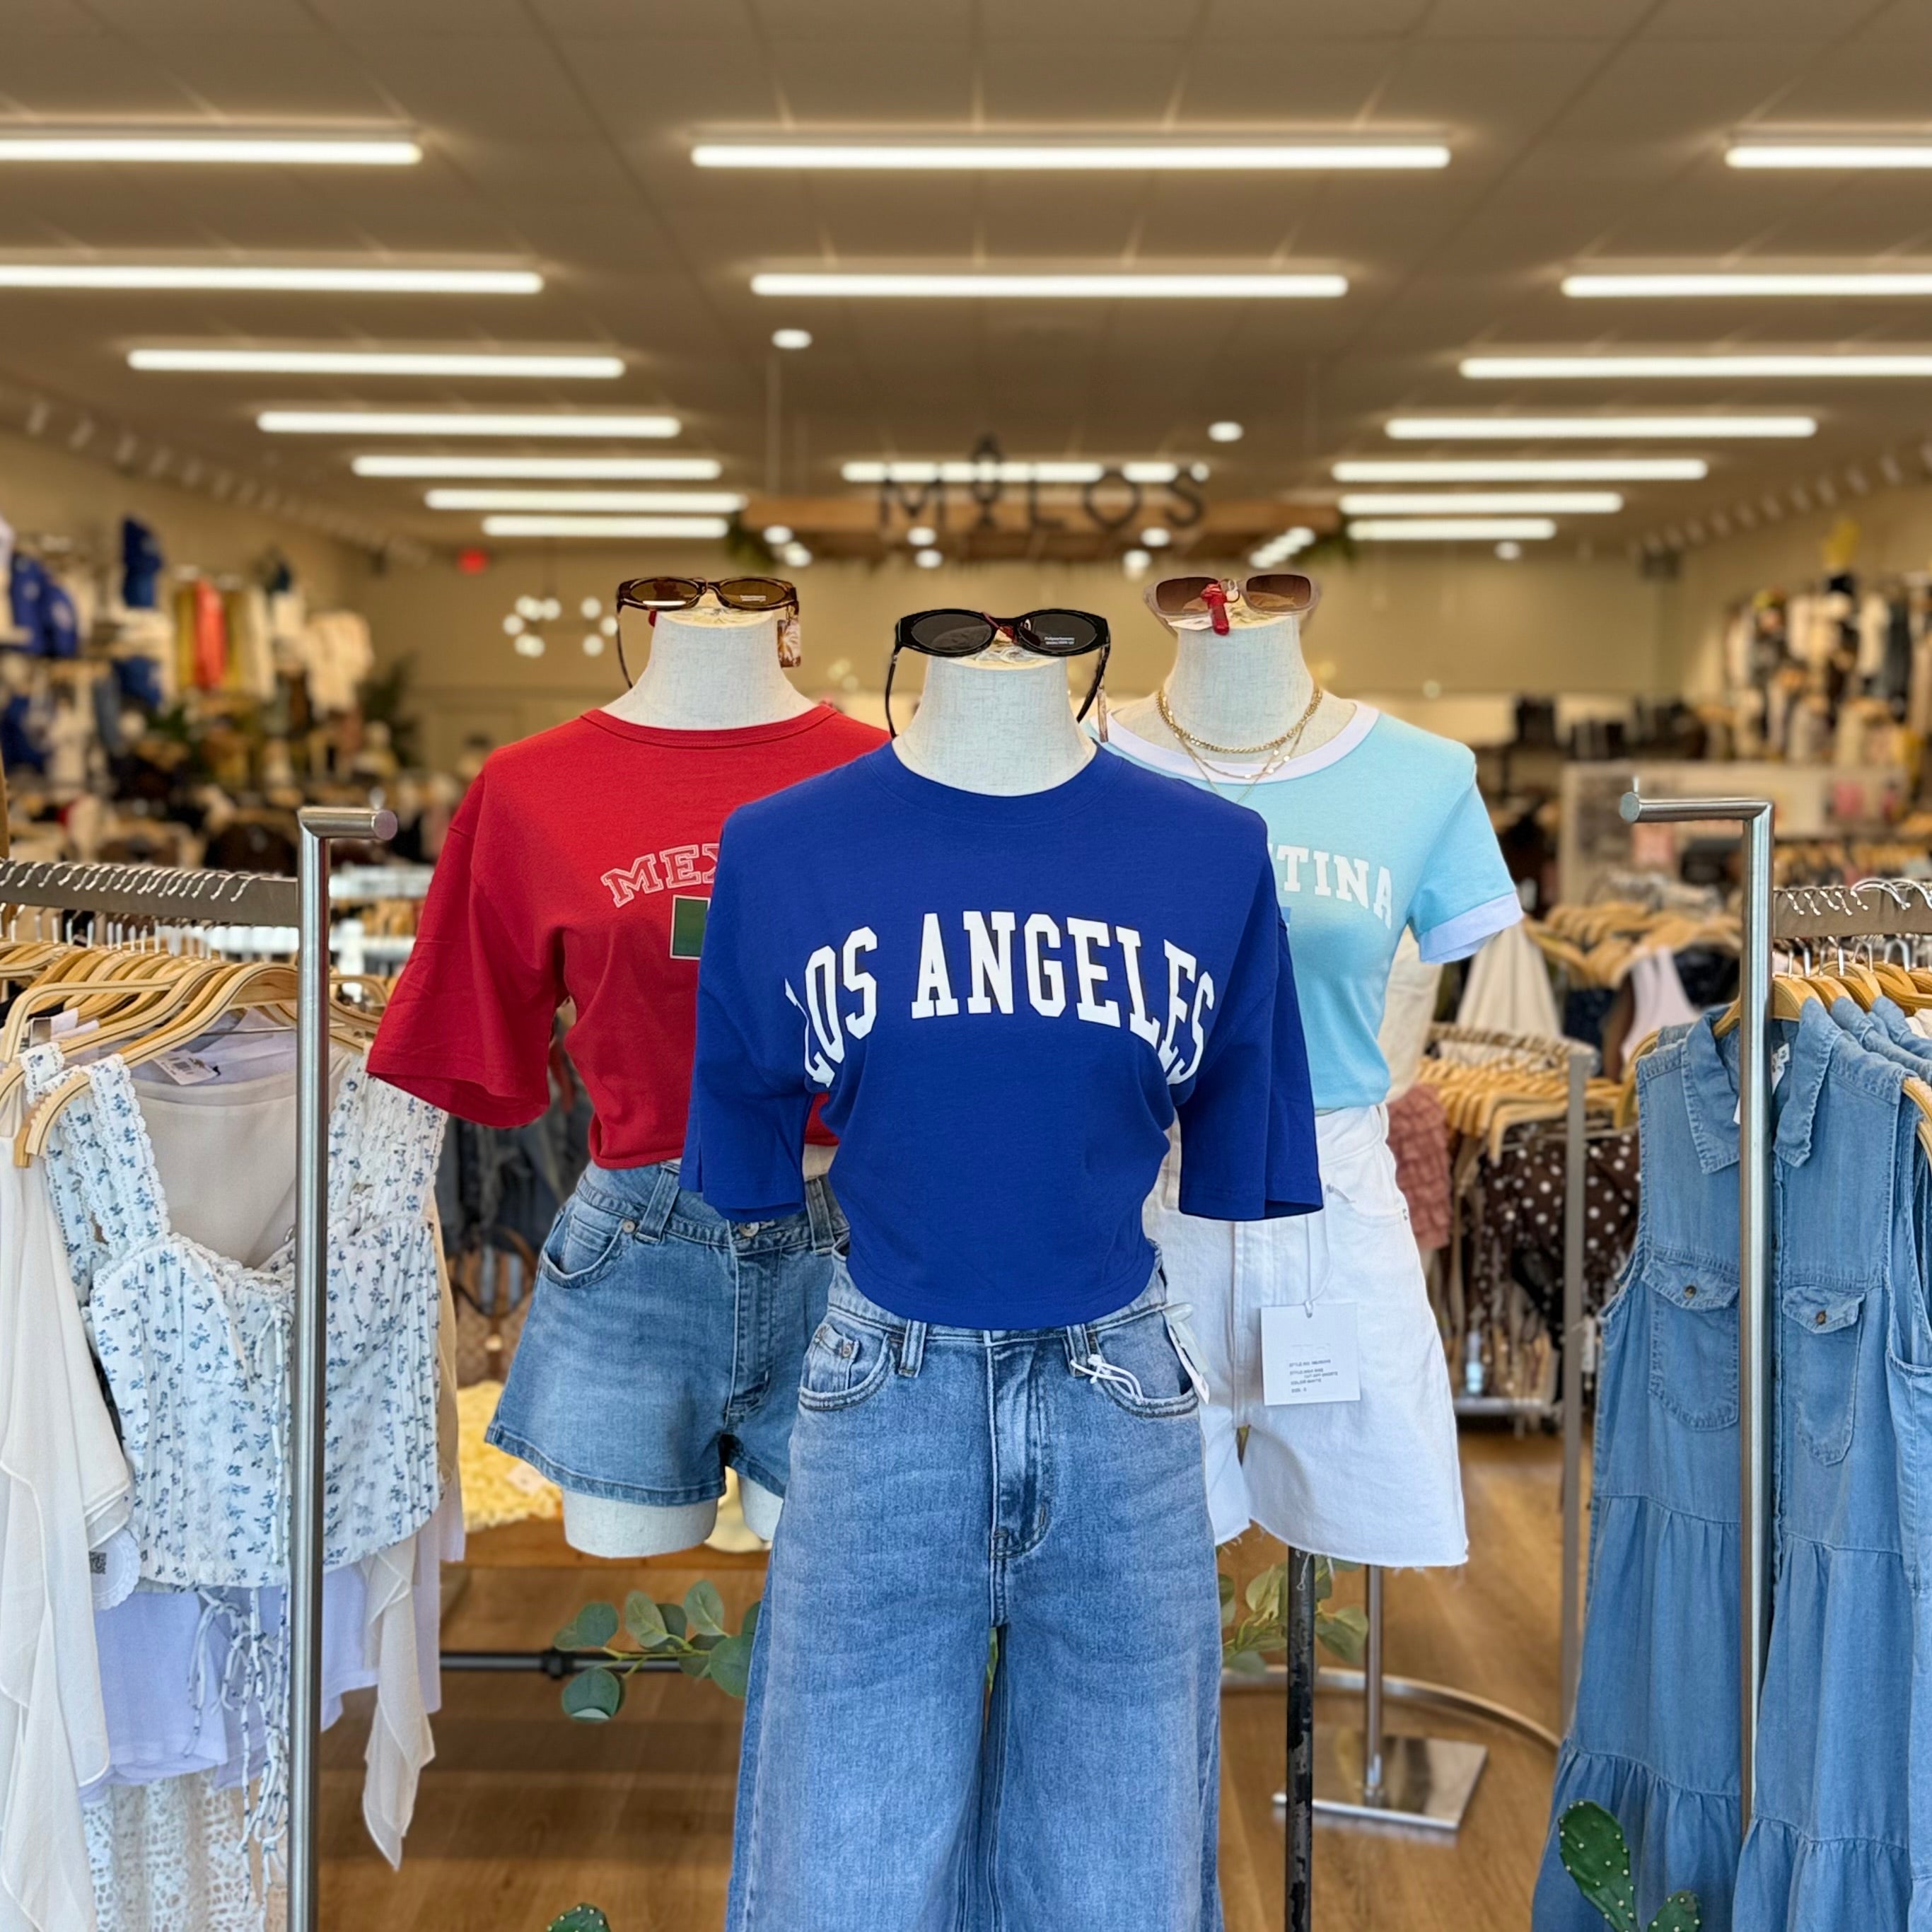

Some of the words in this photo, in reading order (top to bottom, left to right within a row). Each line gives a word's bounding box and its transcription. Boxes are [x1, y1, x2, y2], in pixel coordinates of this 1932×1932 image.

[1267, 843, 1392, 931] TINA
[784, 926, 878, 1088] LOS
[912, 910, 1214, 1086] ANGELES
